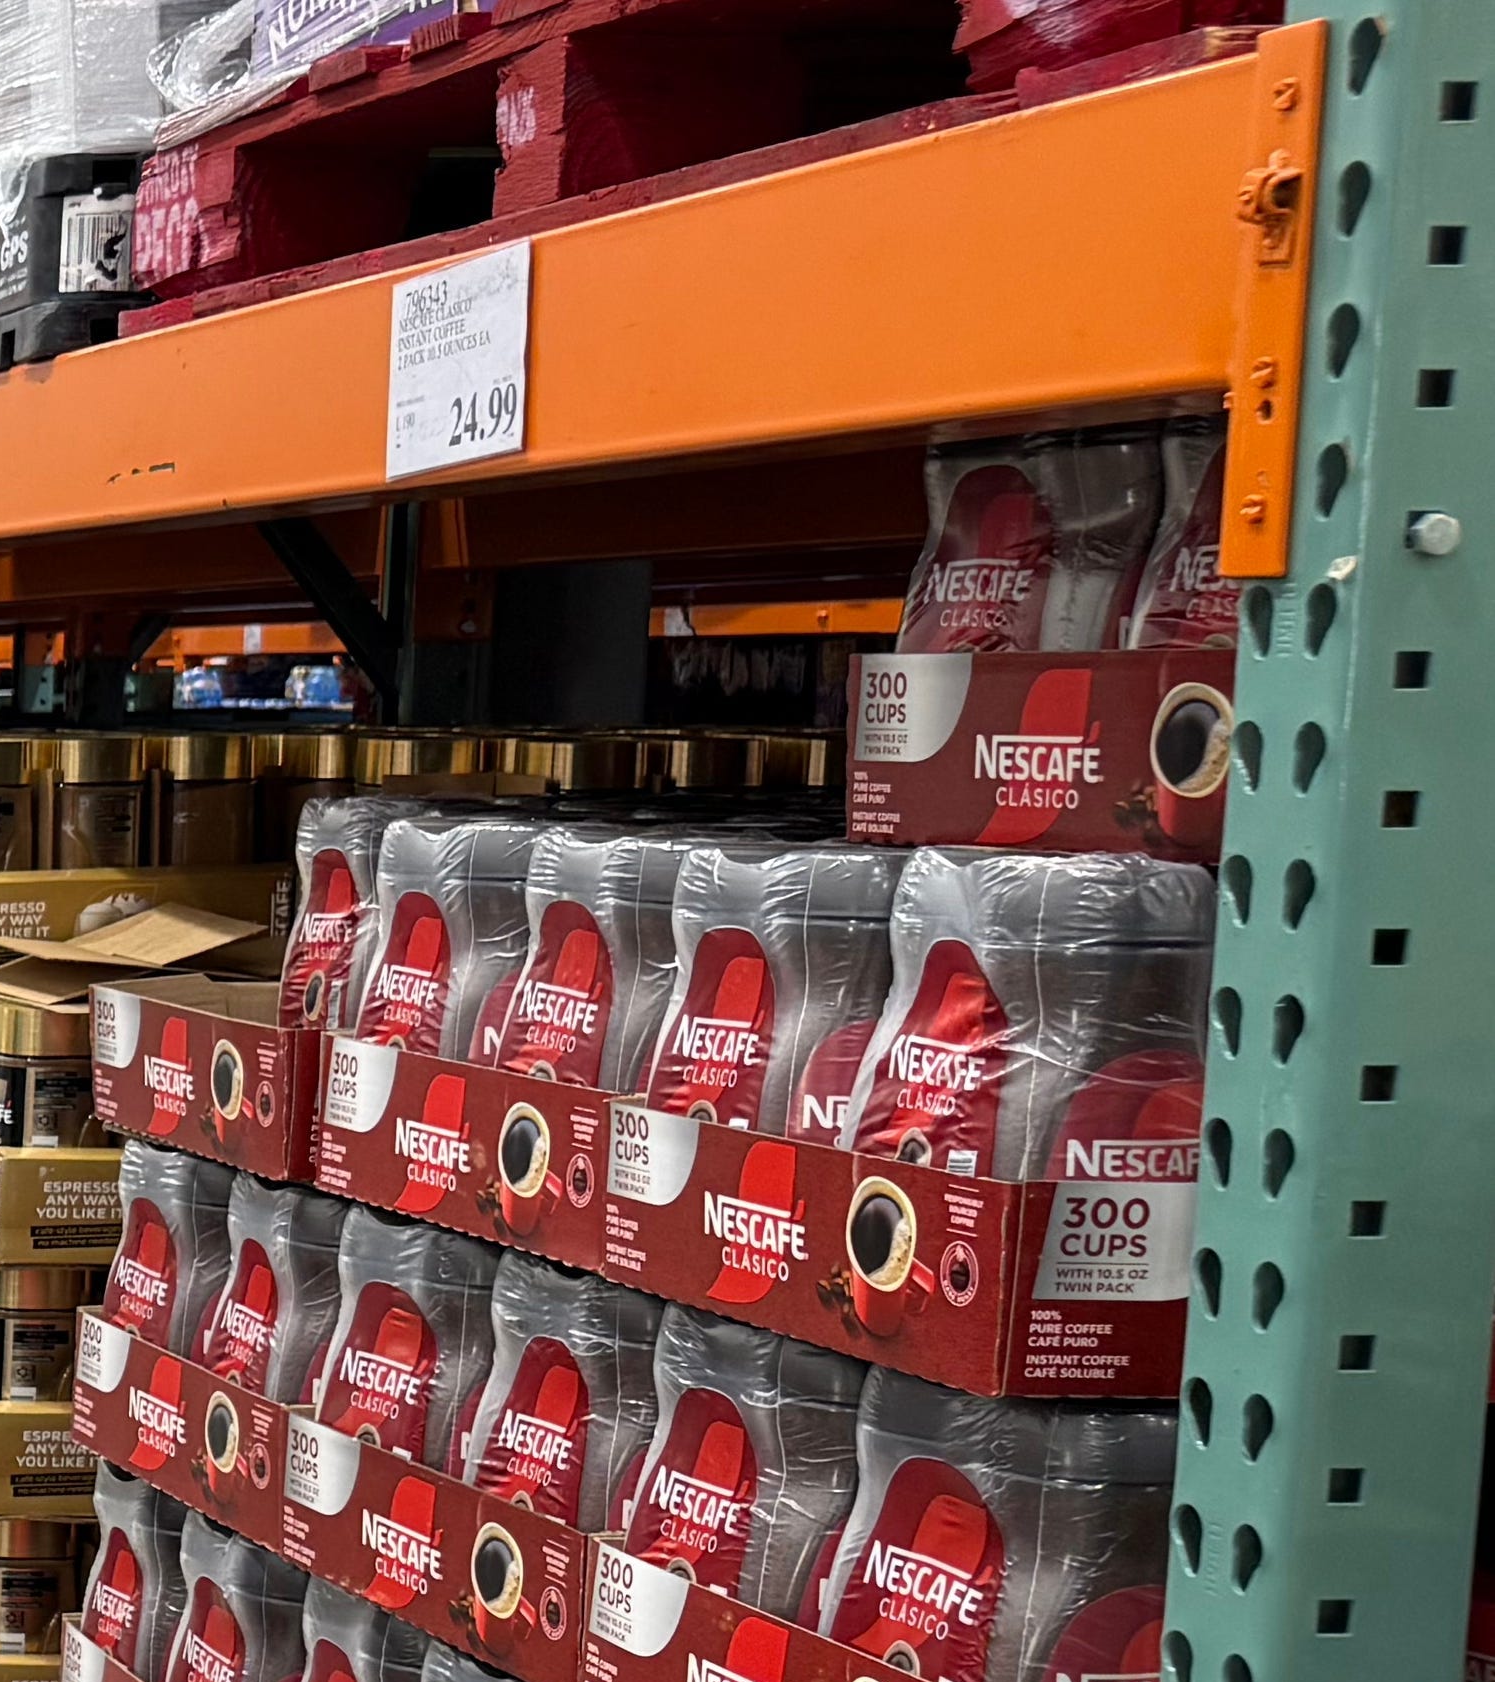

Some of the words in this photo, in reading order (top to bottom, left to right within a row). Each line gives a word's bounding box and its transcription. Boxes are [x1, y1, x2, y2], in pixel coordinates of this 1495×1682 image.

[398, 329, 432, 351] INSTANT
[433, 318, 466, 341] COFFEE
[403, 350, 425, 369] PACK
[443, 334, 477, 357] OUNCES
[448, 382, 518, 447] 24.99
[866, 672, 907, 699] 300
[865, 703, 906, 723] CUPS
[996, 785, 1078, 809] CLÁSICO
[10, 914, 42, 926] WAY
[96, 1001, 116, 1021] 300
[97, 1023, 116, 1040] CUPS
[333, 1052, 358, 1078] 300
[333, 1077, 357, 1099] CUPS
[616, 1110, 649, 1140] 300
[616, 1138, 649, 1166] CUPS
[407, 1162, 456, 1192] CLÁSICO
[46, 1194, 79, 1207] ANY
[82, 1194, 117, 1206] WAY
[37, 1207, 69, 1220] YOU
[72, 1207, 106, 1219] LIKE
[1064, 1198, 1150, 1229] 300
[1060, 1235, 1148, 1258] CUPS
[722, 1246, 789, 1282] CLÁSICO
[1056, 1269, 1094, 1280] WITH
[1097, 1269, 1125, 1280] 10.5
[1128, 1269, 1149, 1280] OZ
[1055, 1282, 1093, 1294] TWIN
[1096, 1282, 1134, 1294] PACK
[1031, 1310, 1061, 1321] 100%
[1028, 1335, 1060, 1348] CAFÉ
[1063, 1337, 1098, 1348] PURO
[1029, 1323, 1062, 1335] PURE
[1065, 1324, 1113, 1335] COFFEE
[1025, 1366, 1057, 1379] CAFÉ
[1060, 1368, 1115, 1379] SOLUBLE
[1026, 1355, 1079, 1366] INSTANT
[1082, 1355, 1129, 1367] COFFEE
[291, 1428, 319, 1458] 300
[16, 1456, 46, 1468] YOU
[52, 1456, 85, 1468] LIKE
[291, 1455, 318, 1481] CUPS
[660, 1518, 718, 1553] CLÁSICO
[375, 1557, 428, 1596] CLÁSICO
[600, 1553, 634, 1588] 300
[599, 1582, 632, 1614] CUPS
[878, 1597, 949, 1641] CLÁSICO
